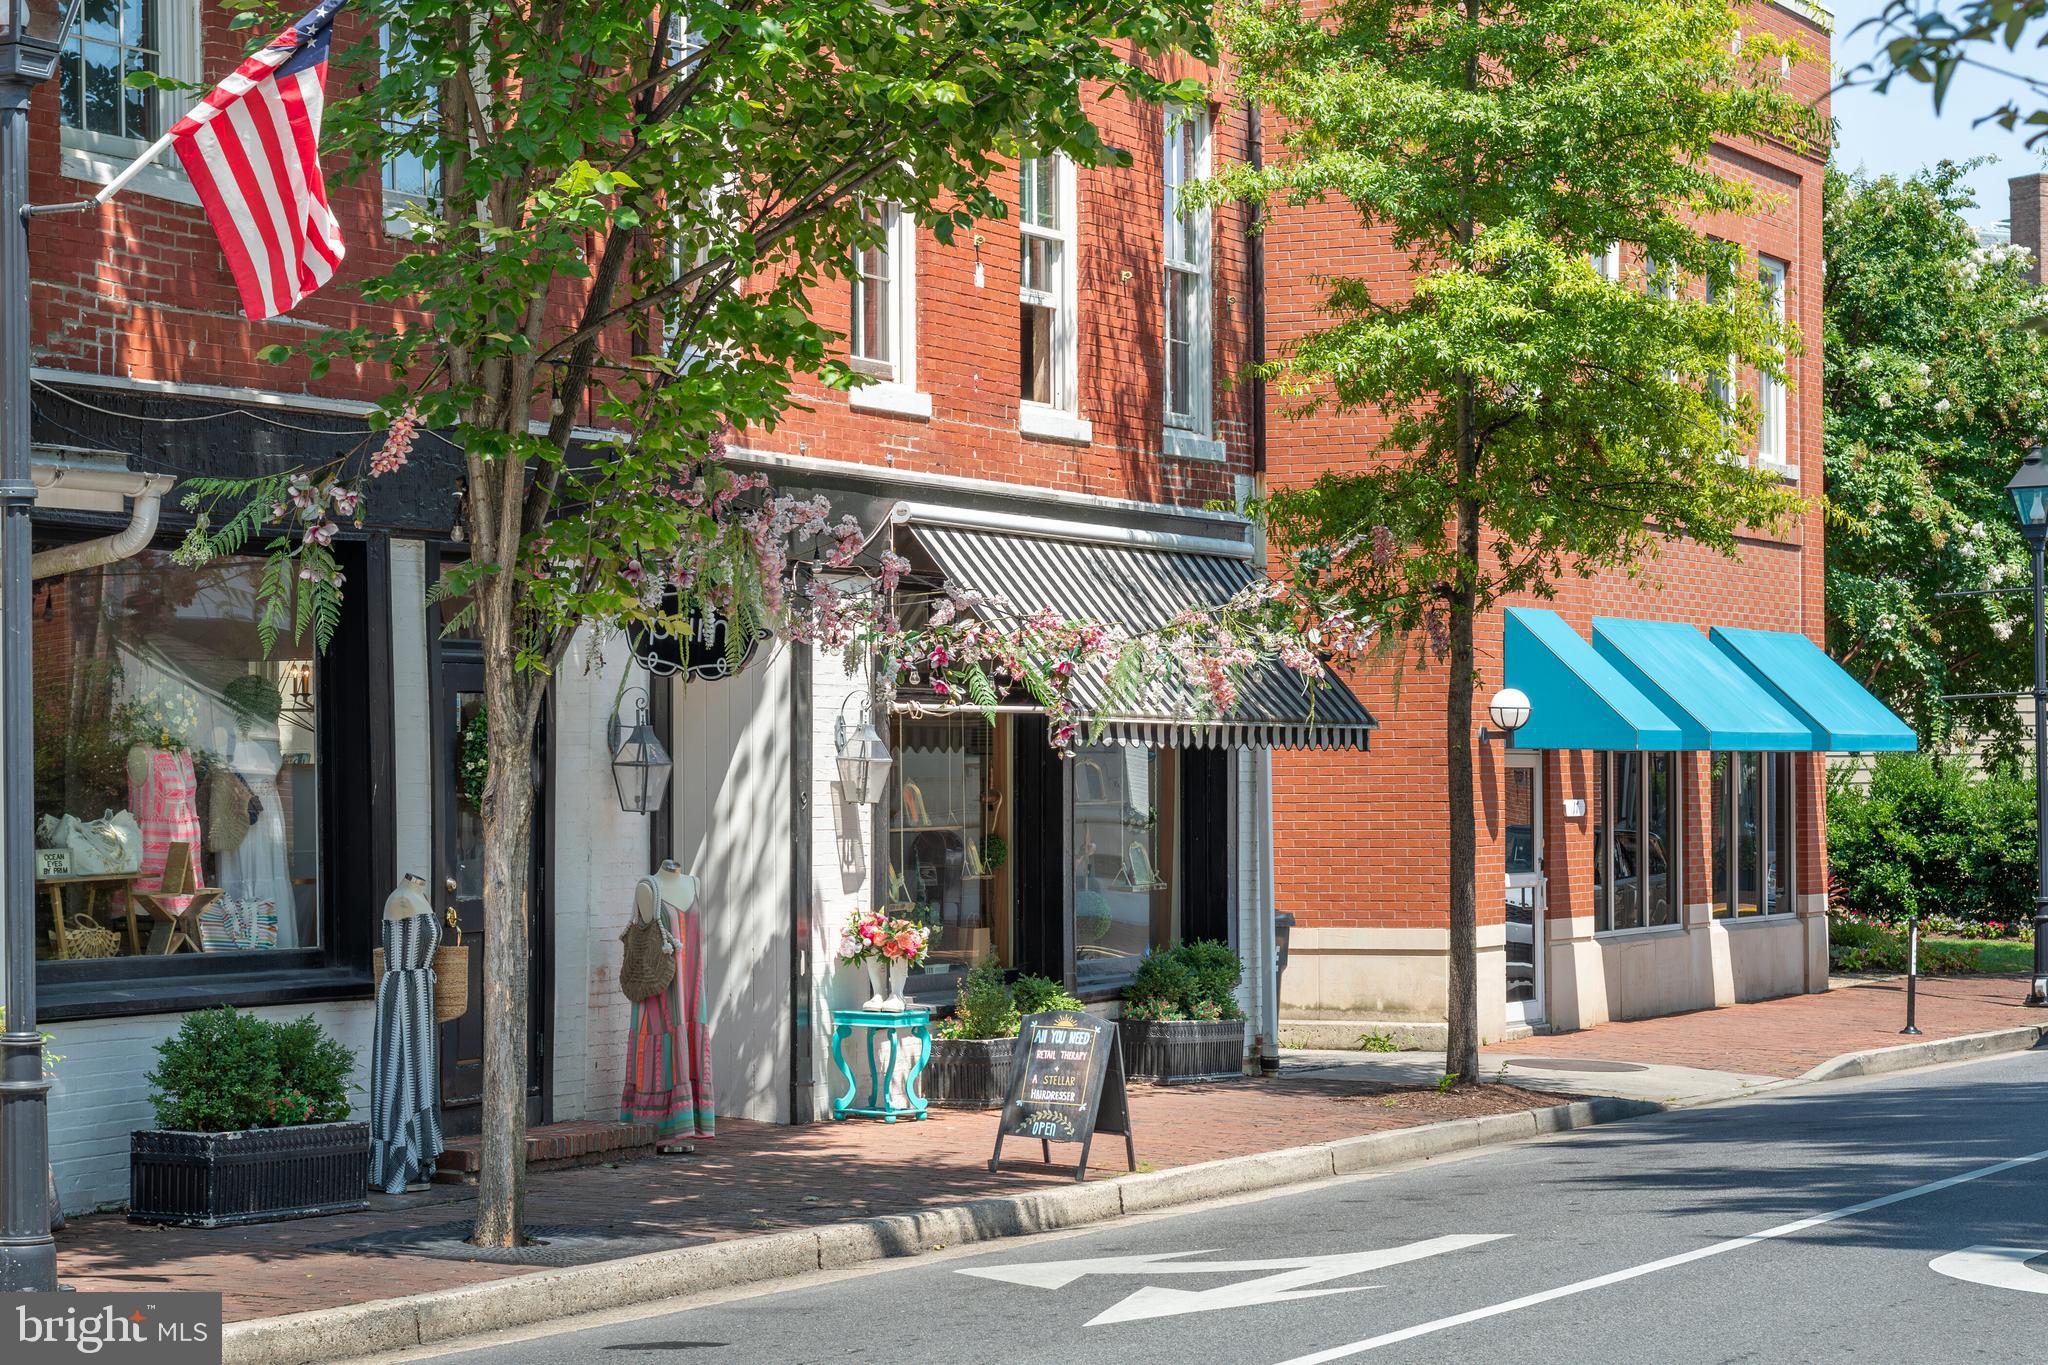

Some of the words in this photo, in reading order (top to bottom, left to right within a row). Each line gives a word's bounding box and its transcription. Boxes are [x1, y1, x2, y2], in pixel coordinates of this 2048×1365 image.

[1051, 1030, 1067, 1044] YOU
[1036, 1050, 1056, 1060] RETAIL
[1061, 1050, 1088, 1060] THERAPY
[1032, 1074, 1038, 1084] A
[1043, 1075, 1075, 1086] STELLAR
